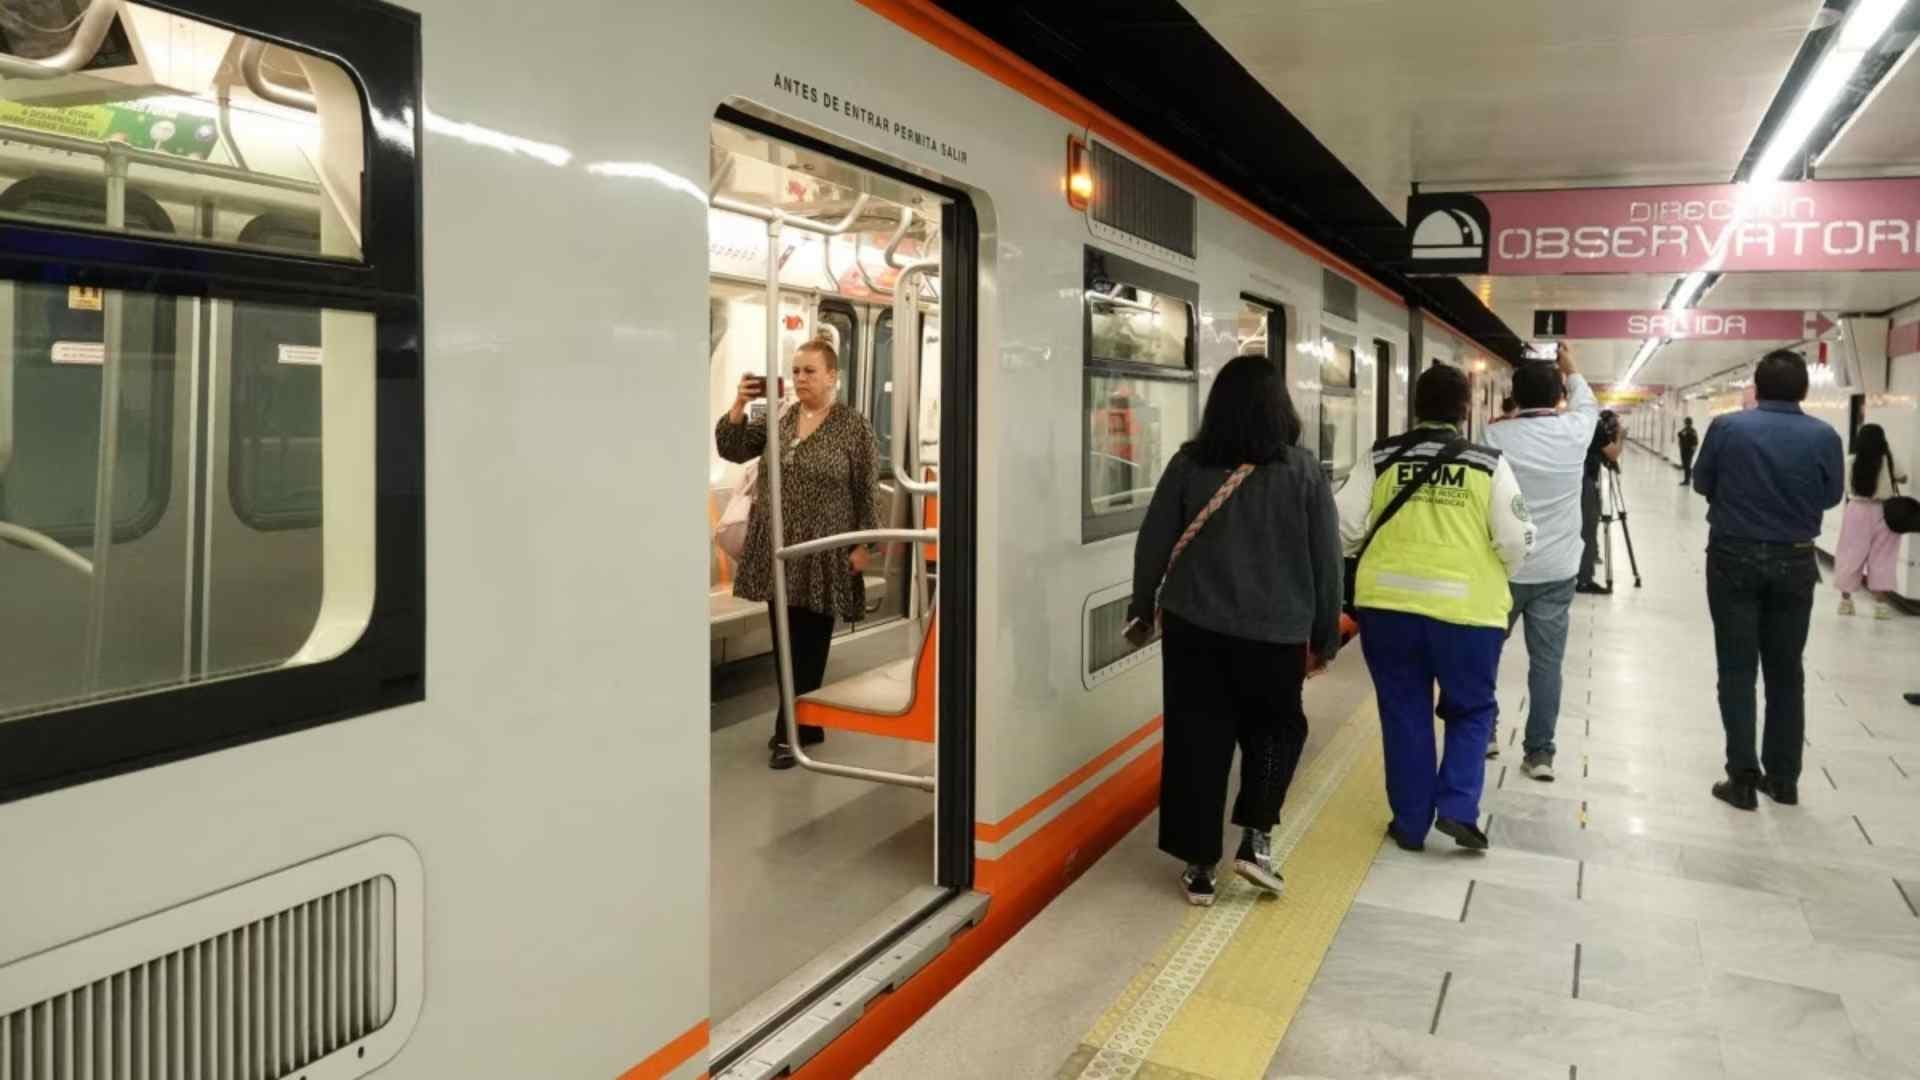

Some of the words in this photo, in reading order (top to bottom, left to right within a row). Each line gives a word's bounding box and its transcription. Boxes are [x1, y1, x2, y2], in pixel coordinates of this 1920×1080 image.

[773, 73, 818, 103] ANTES
[823, 92, 840, 112] DE
[844, 102, 889, 132] ENTRAR
[893, 123, 938, 152] PERMITA
[941, 142, 967, 164] SALIR
[1627, 315, 1746, 336] SALIDA
